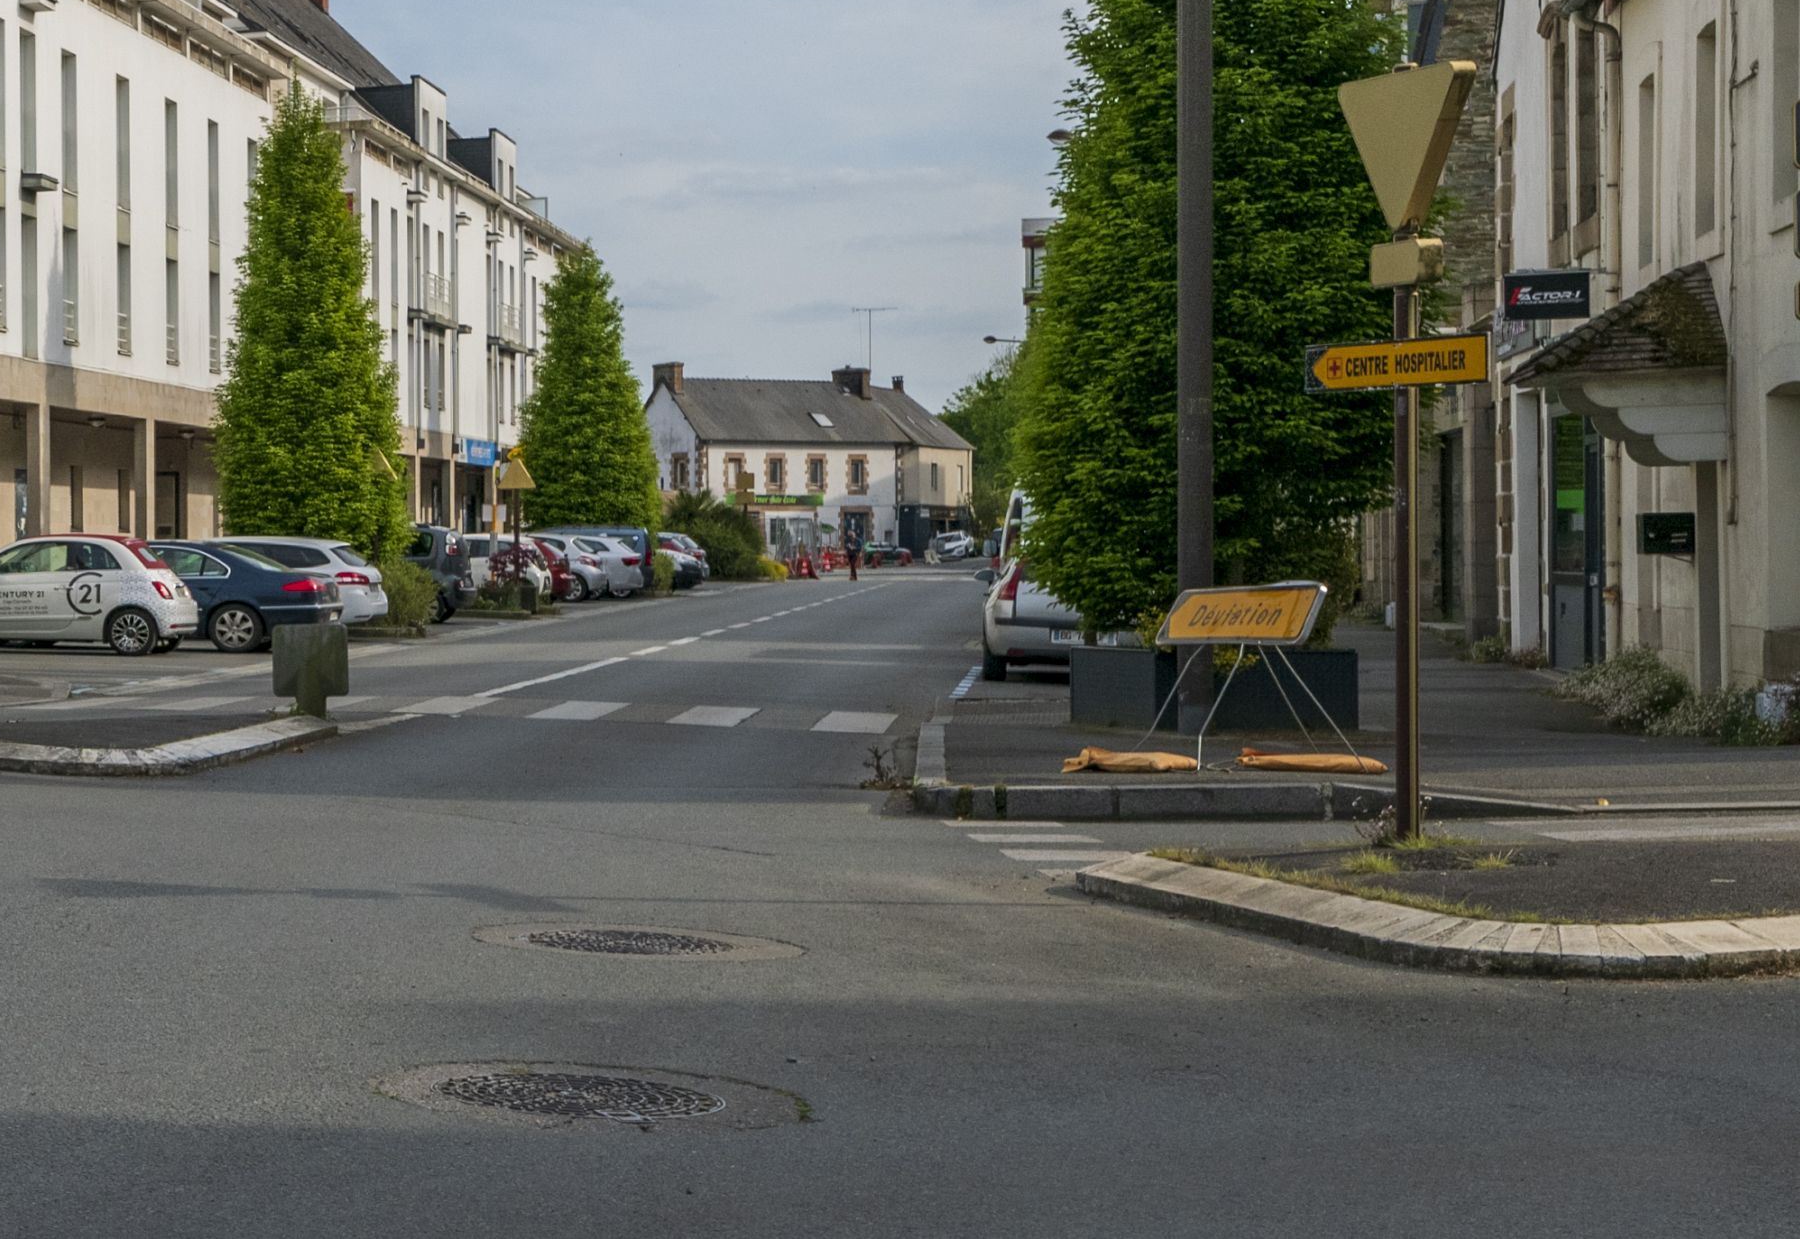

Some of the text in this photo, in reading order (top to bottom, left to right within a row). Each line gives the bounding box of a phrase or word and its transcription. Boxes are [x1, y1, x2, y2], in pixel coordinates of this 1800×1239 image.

[1345, 350, 1466, 377] CENTRE HOSPITALIER
[36, 590, 45, 598] 21
[1188, 603, 1282, 627] Déviation
